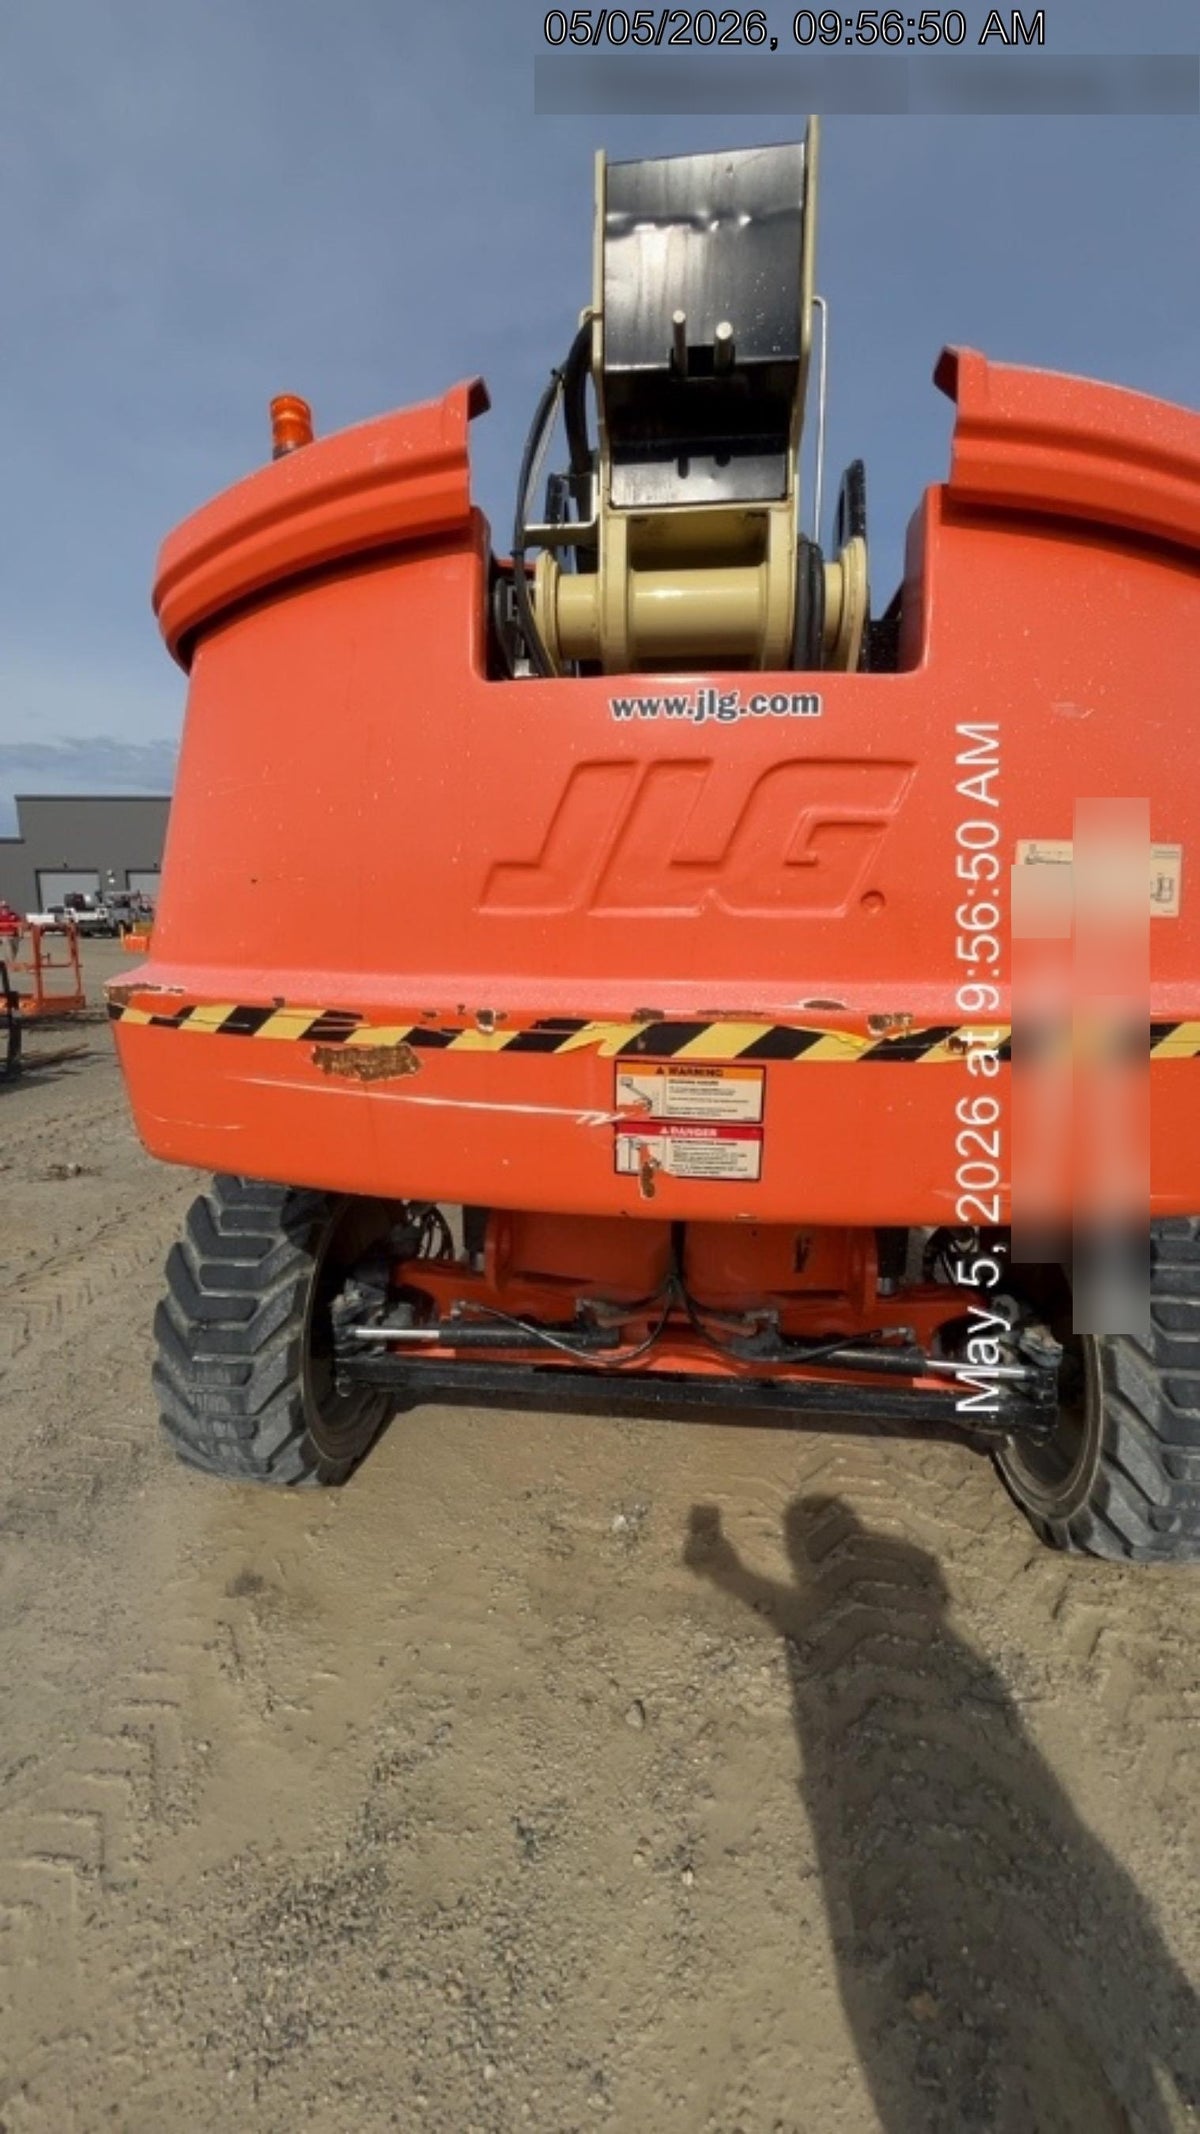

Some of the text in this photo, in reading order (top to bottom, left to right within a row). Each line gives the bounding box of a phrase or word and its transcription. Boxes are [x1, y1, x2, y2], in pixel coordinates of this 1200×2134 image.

[611, 689, 821, 723] www.jlg.com
[475, 757, 918, 917] JLG
[668, 1067, 724, 1077] WARNING
[671, 1127, 718, 1137] DANGER
